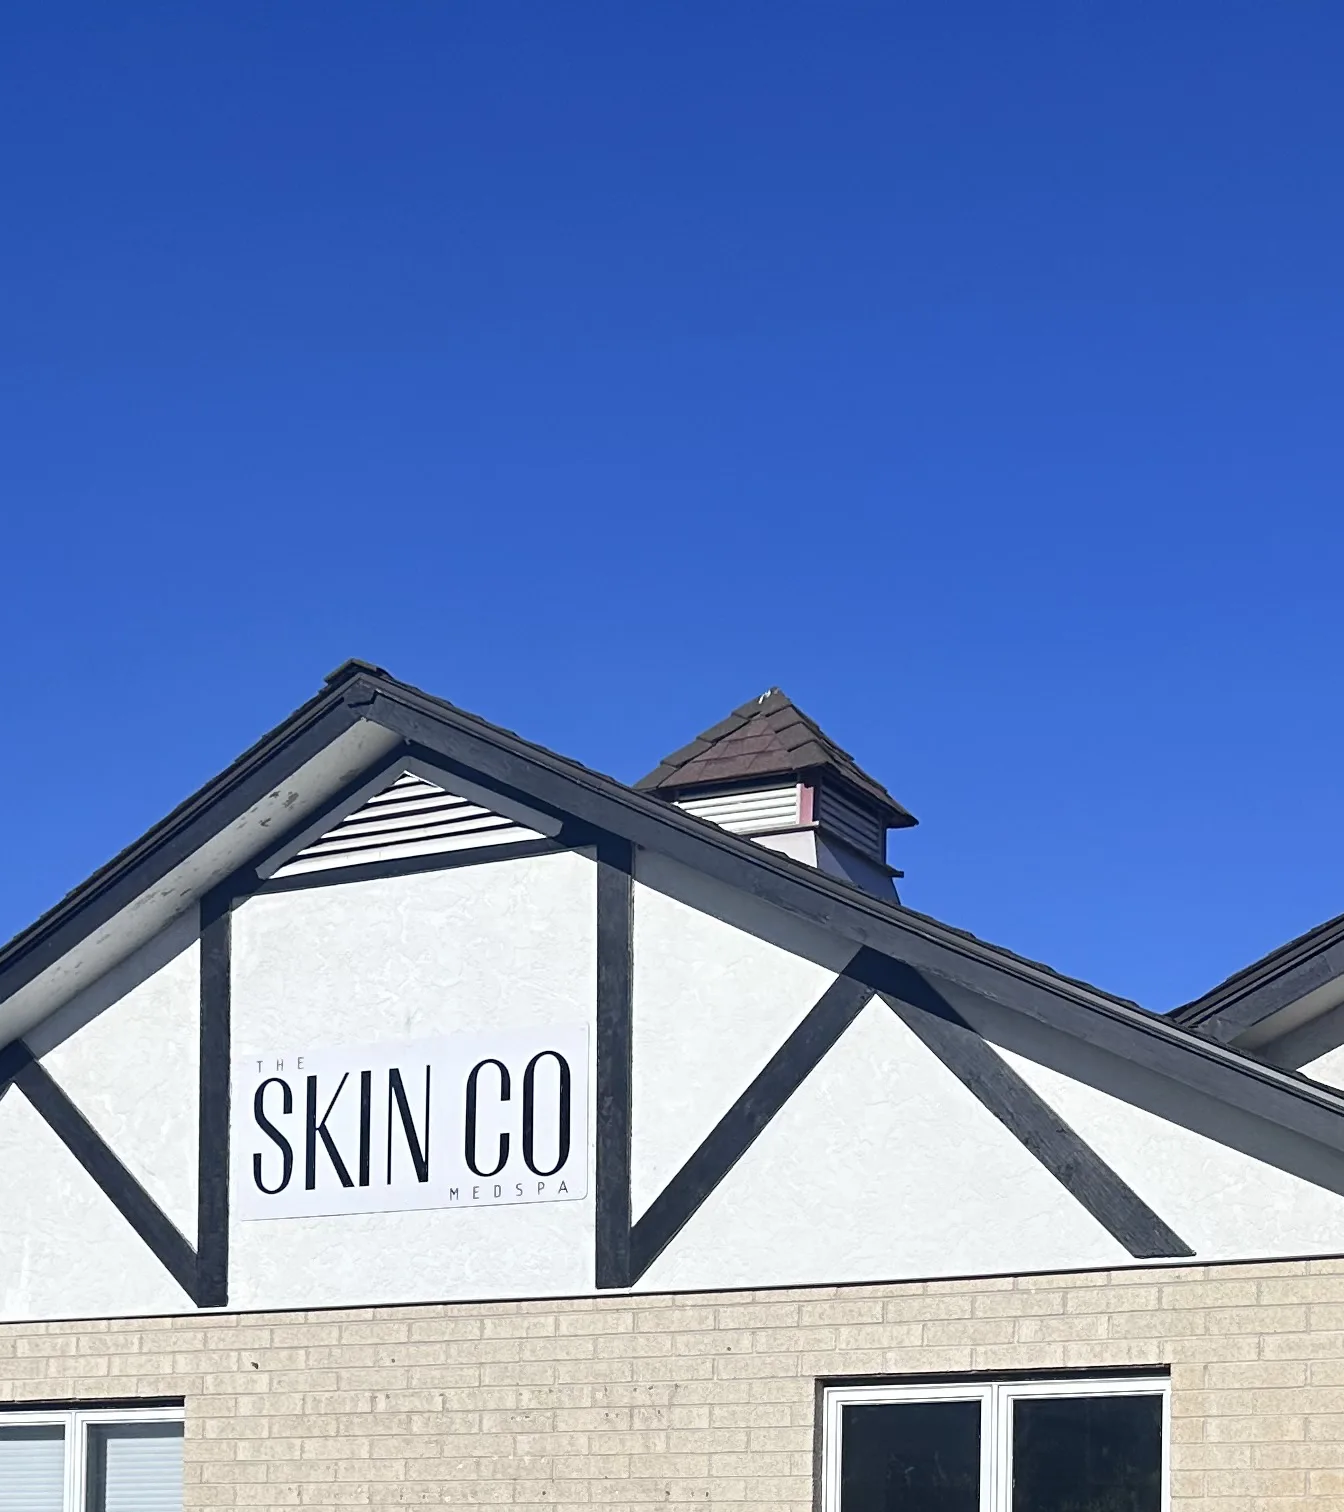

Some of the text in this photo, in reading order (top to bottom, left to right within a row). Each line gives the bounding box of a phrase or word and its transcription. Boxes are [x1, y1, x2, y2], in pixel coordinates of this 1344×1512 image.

[256, 1056, 304, 1072] THE
[252, 1050, 572, 1195] SKIN CO
[449, 1180, 569, 1201] MEDSPA
